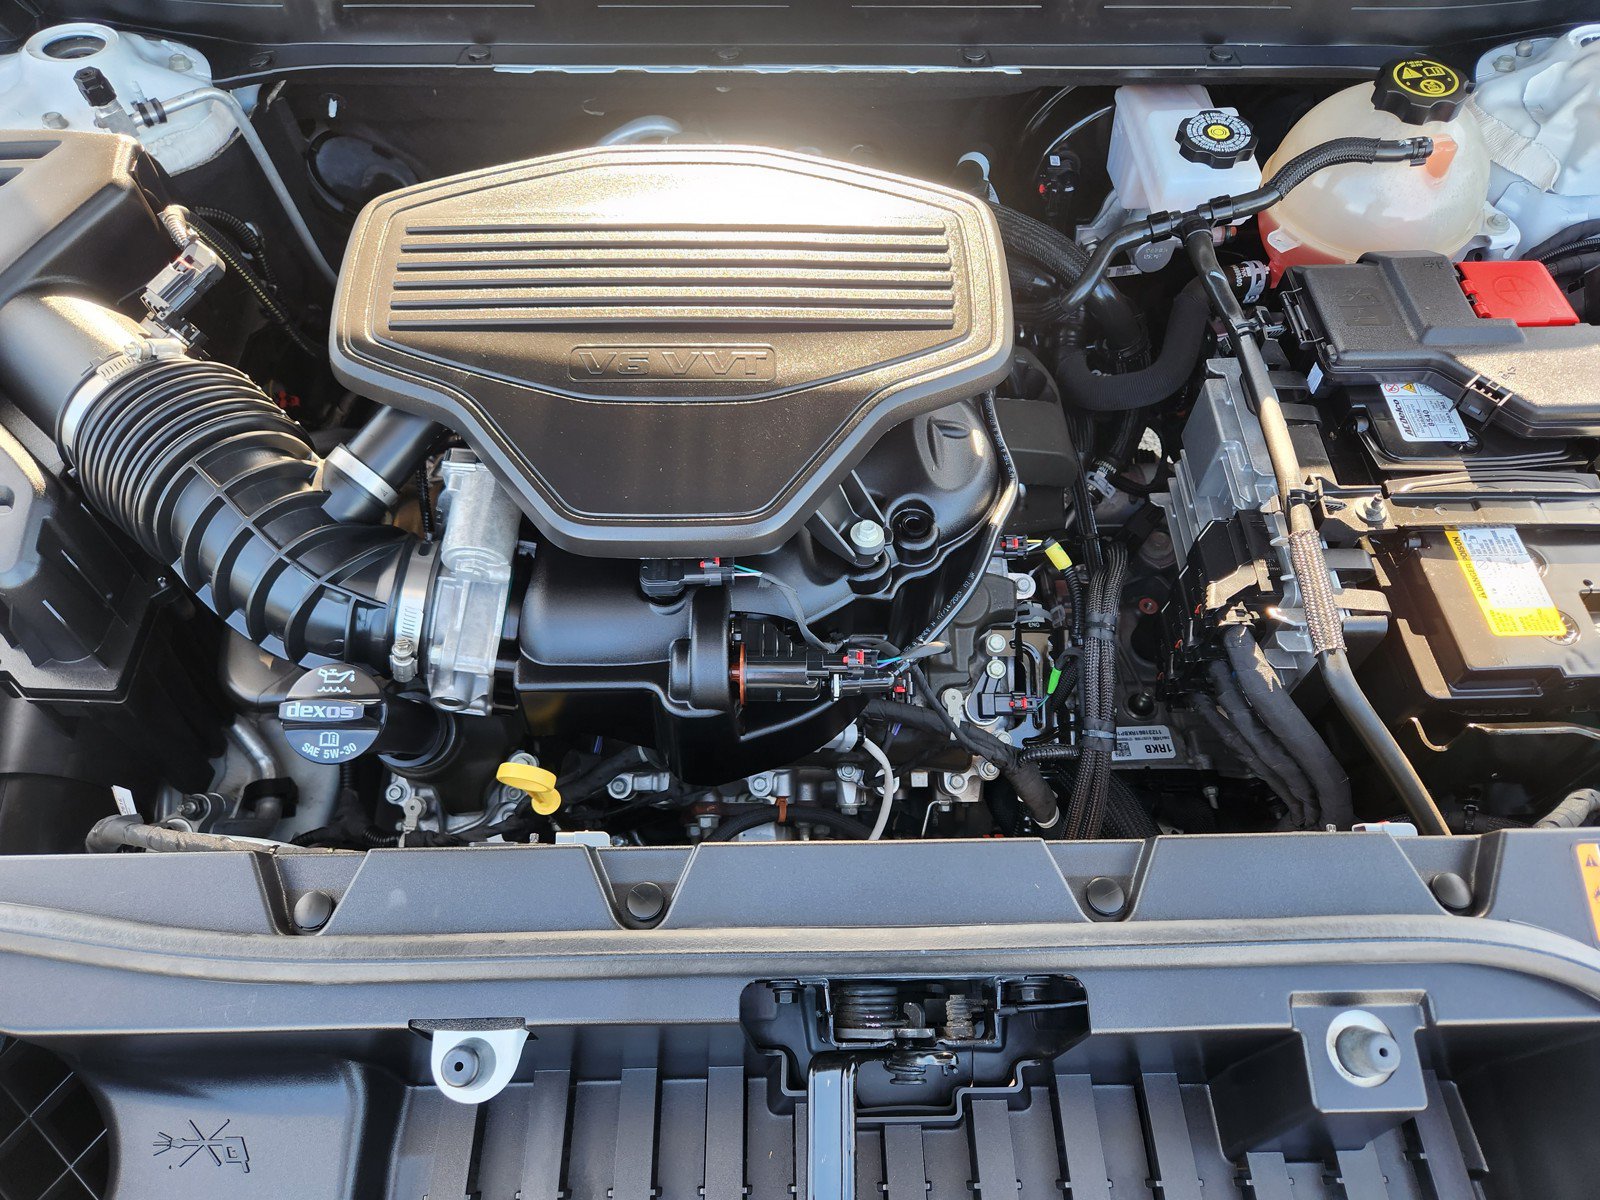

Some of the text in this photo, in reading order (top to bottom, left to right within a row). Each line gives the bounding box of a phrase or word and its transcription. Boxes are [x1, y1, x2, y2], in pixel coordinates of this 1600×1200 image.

[579, 351, 767, 375] V6 VVT
[1393, 400, 1414, 437] ACDelco
[1451, 536, 1469, 561] POISON
[286, 702, 355, 718] dexos
[301, 742, 357, 759] SAE 5W-30
[1144, 743, 1173, 753] 1RKB
